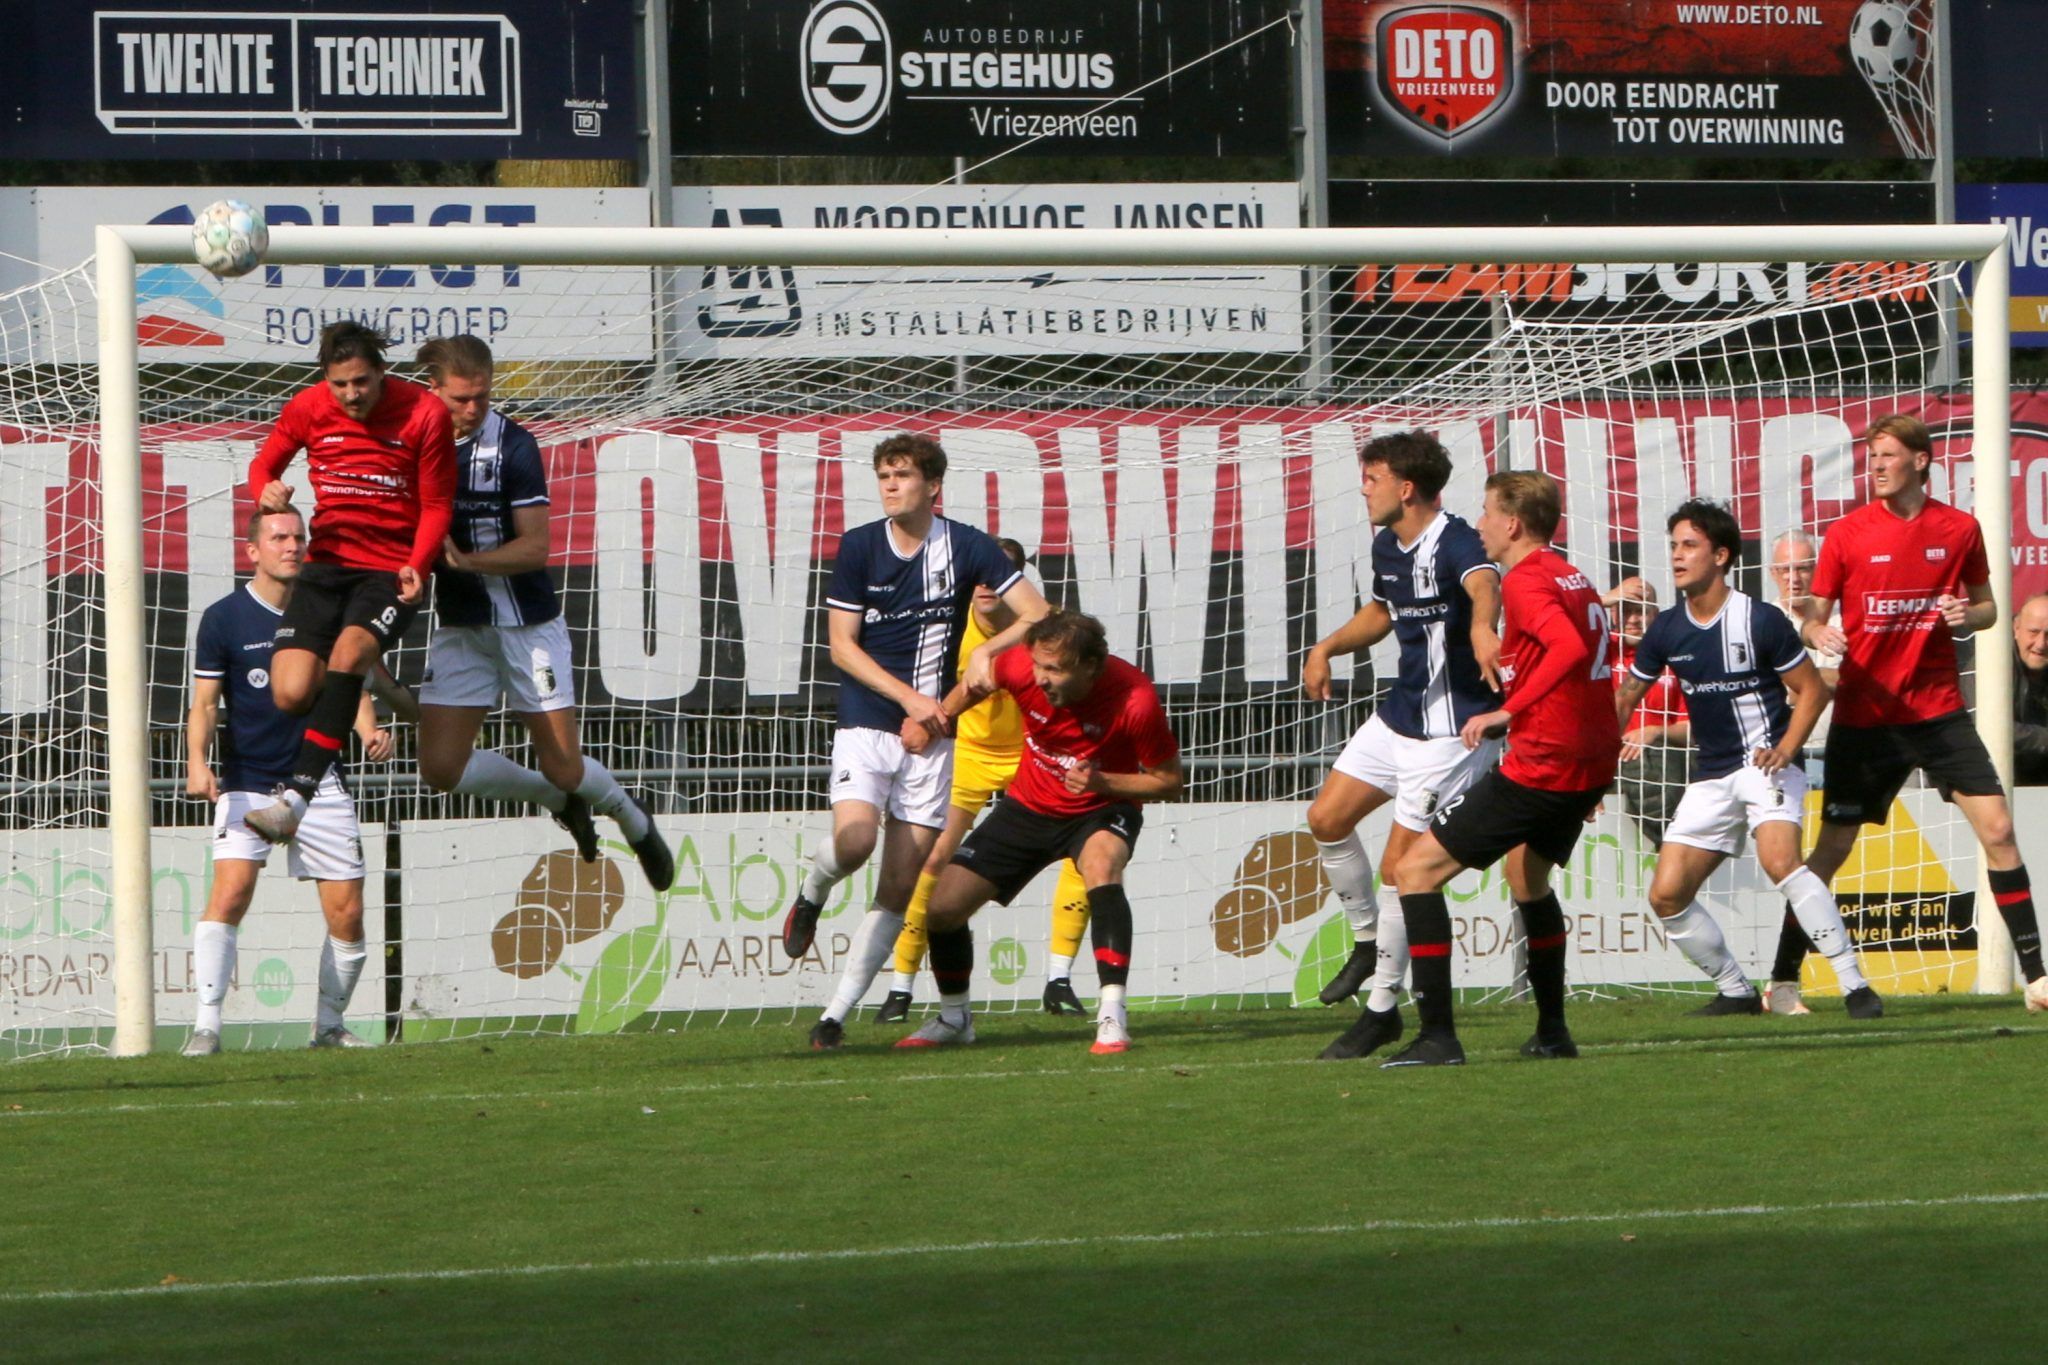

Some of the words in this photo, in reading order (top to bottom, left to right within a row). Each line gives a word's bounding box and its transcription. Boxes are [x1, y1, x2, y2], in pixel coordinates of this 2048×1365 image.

[1677, 4, 1823, 25] WWW.DETO.NL
[923, 28, 1085, 45] AUTOBEDRIJF
[1395, 28, 1495, 79] DETO
[117, 33, 274, 94] TWENTE
[314, 37, 486, 97] TECHNIEK
[899, 51, 1114, 89] STEGEHUIS
[1396, 82, 1495, 97] VRIEZENVEEN
[1546, 81, 1616, 109] DOOR
[1626, 82, 1779, 110] EENDRACHT
[971, 106, 1138, 138] Vriezenveen
[1613, 118, 1659, 143] TOT
[1669, 118, 1845, 145] OVERWINNING
[815, 306, 1267, 337] INSTALLATIEBEDRIJVEN
[381, 606, 398, 625] 6
[1695, 677, 1760, 693] wehkamp
[1869, 899, 1902, 917] wie
[1910, 902, 1944, 917] aan
[1901, 922, 1958, 941] denkt
[989, 953, 1023, 970] .NL
